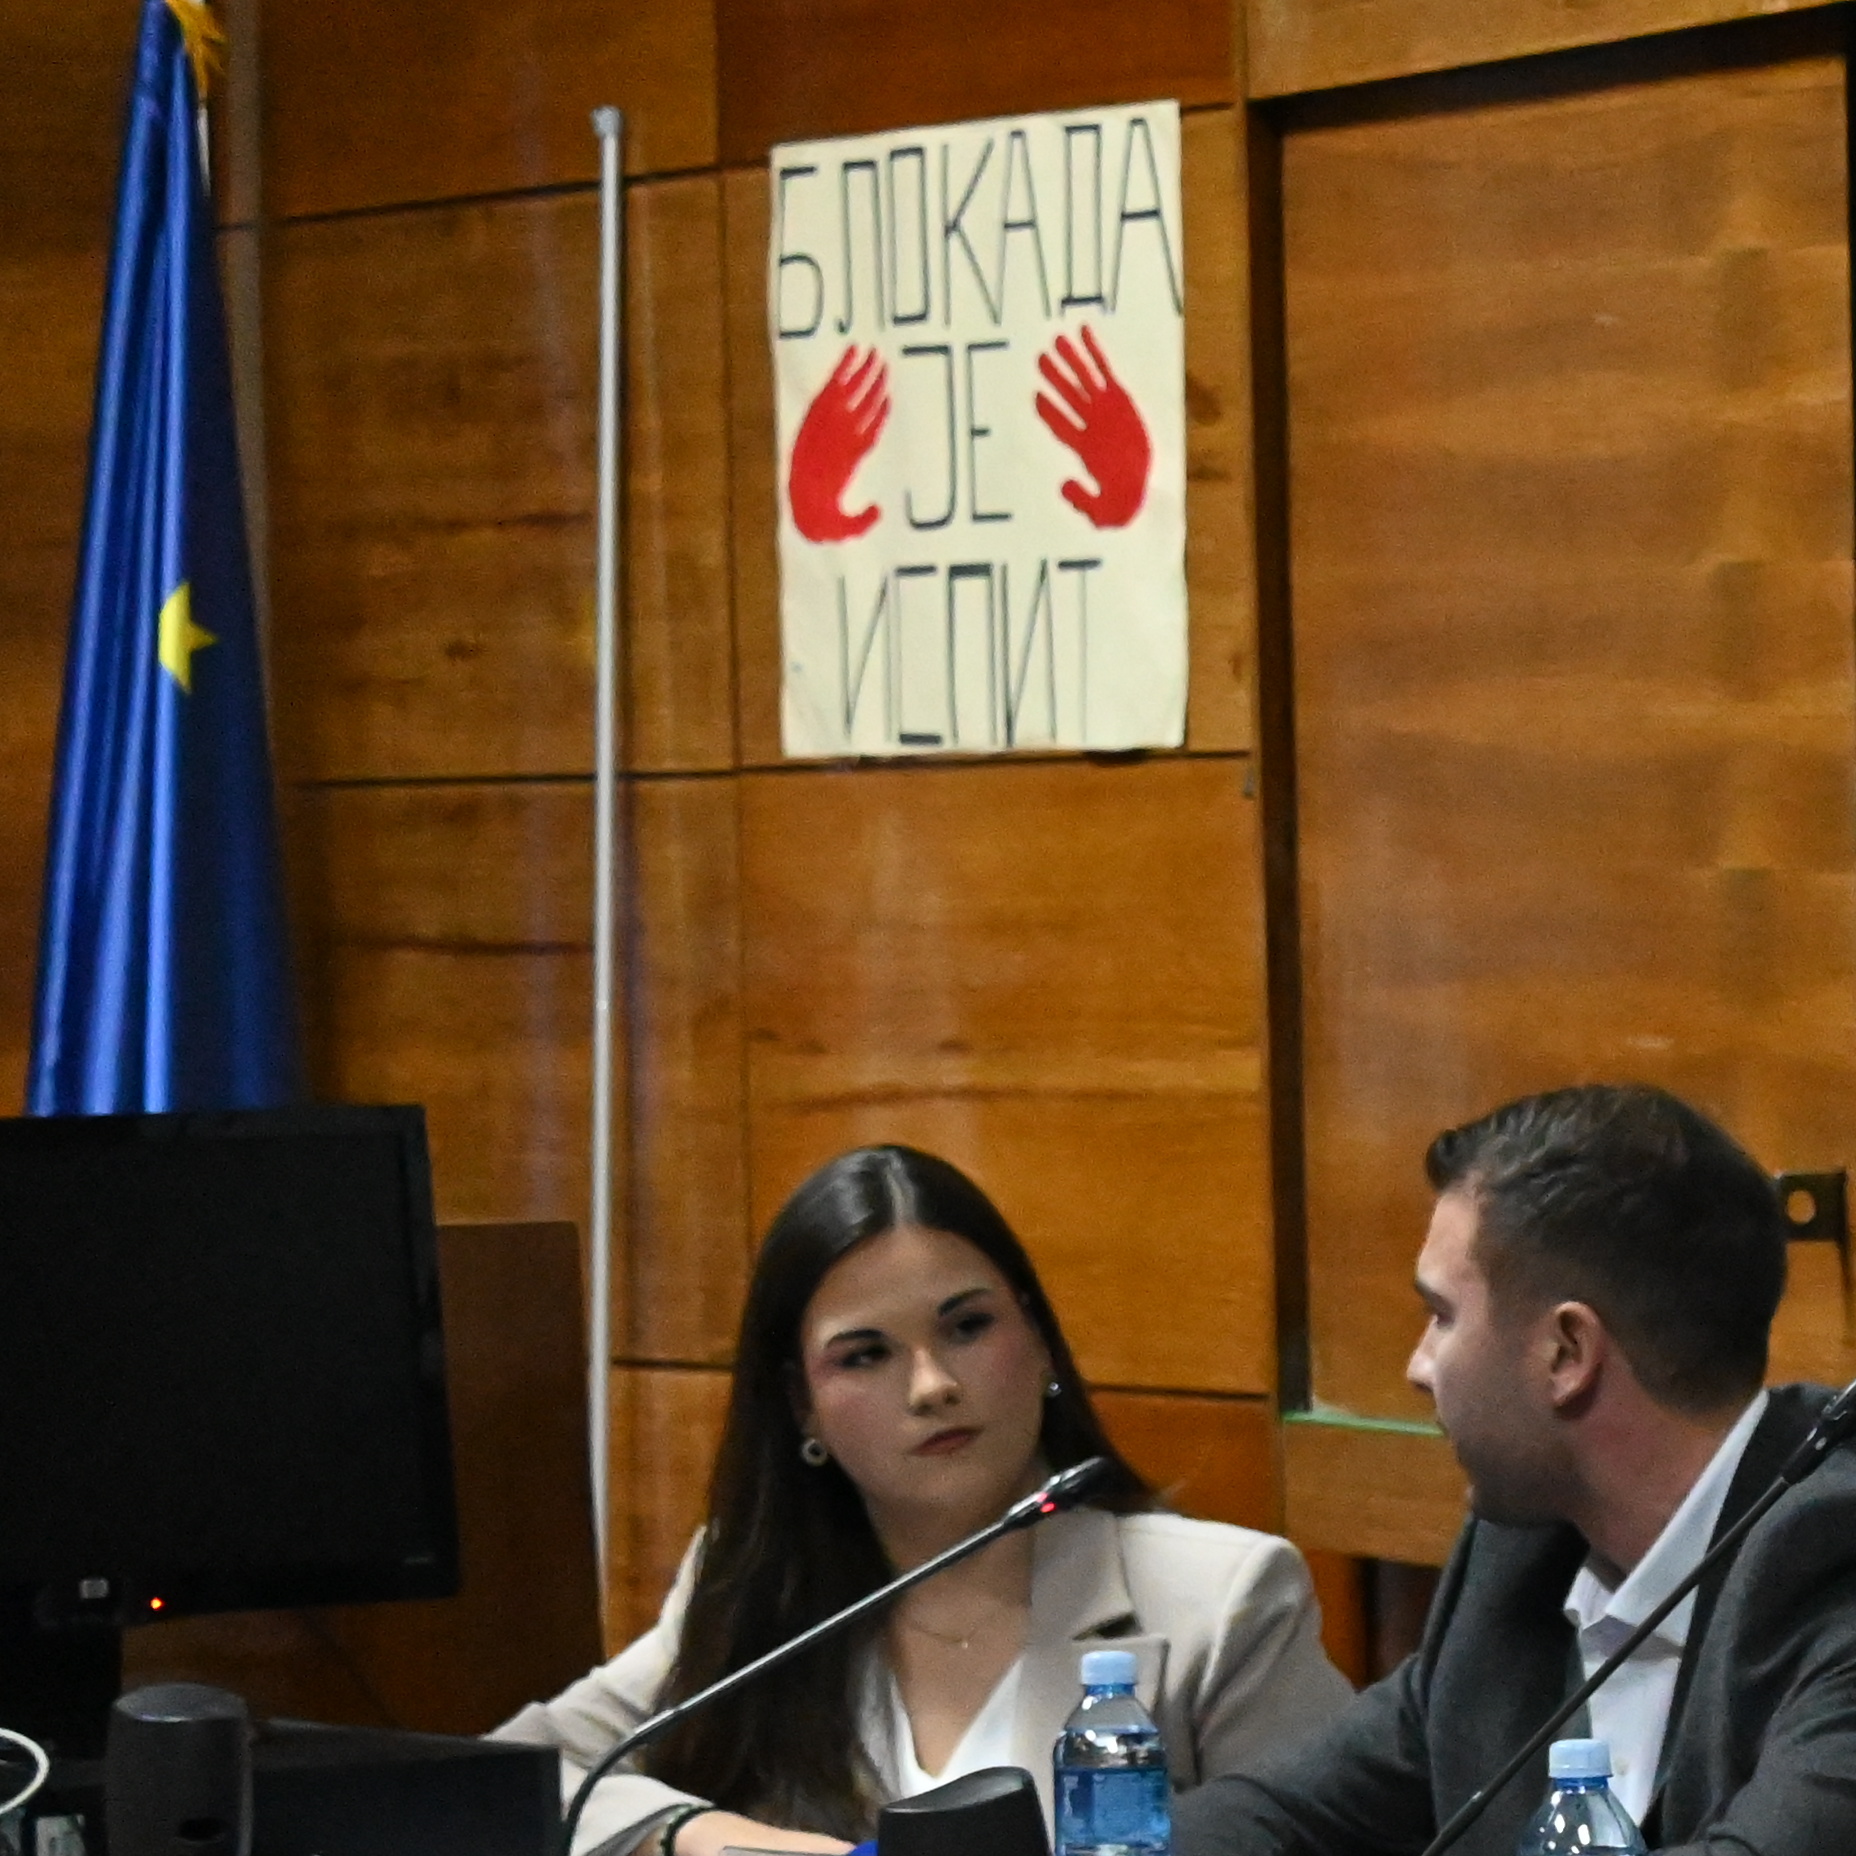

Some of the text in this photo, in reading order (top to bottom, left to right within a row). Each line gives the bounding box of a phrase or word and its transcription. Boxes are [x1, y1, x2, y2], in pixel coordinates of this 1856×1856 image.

[777, 116, 1183, 340] БЛОКАДА
[901, 340, 1011, 530] ЈЕ
[837, 556, 1103, 748] ИСПИТ
